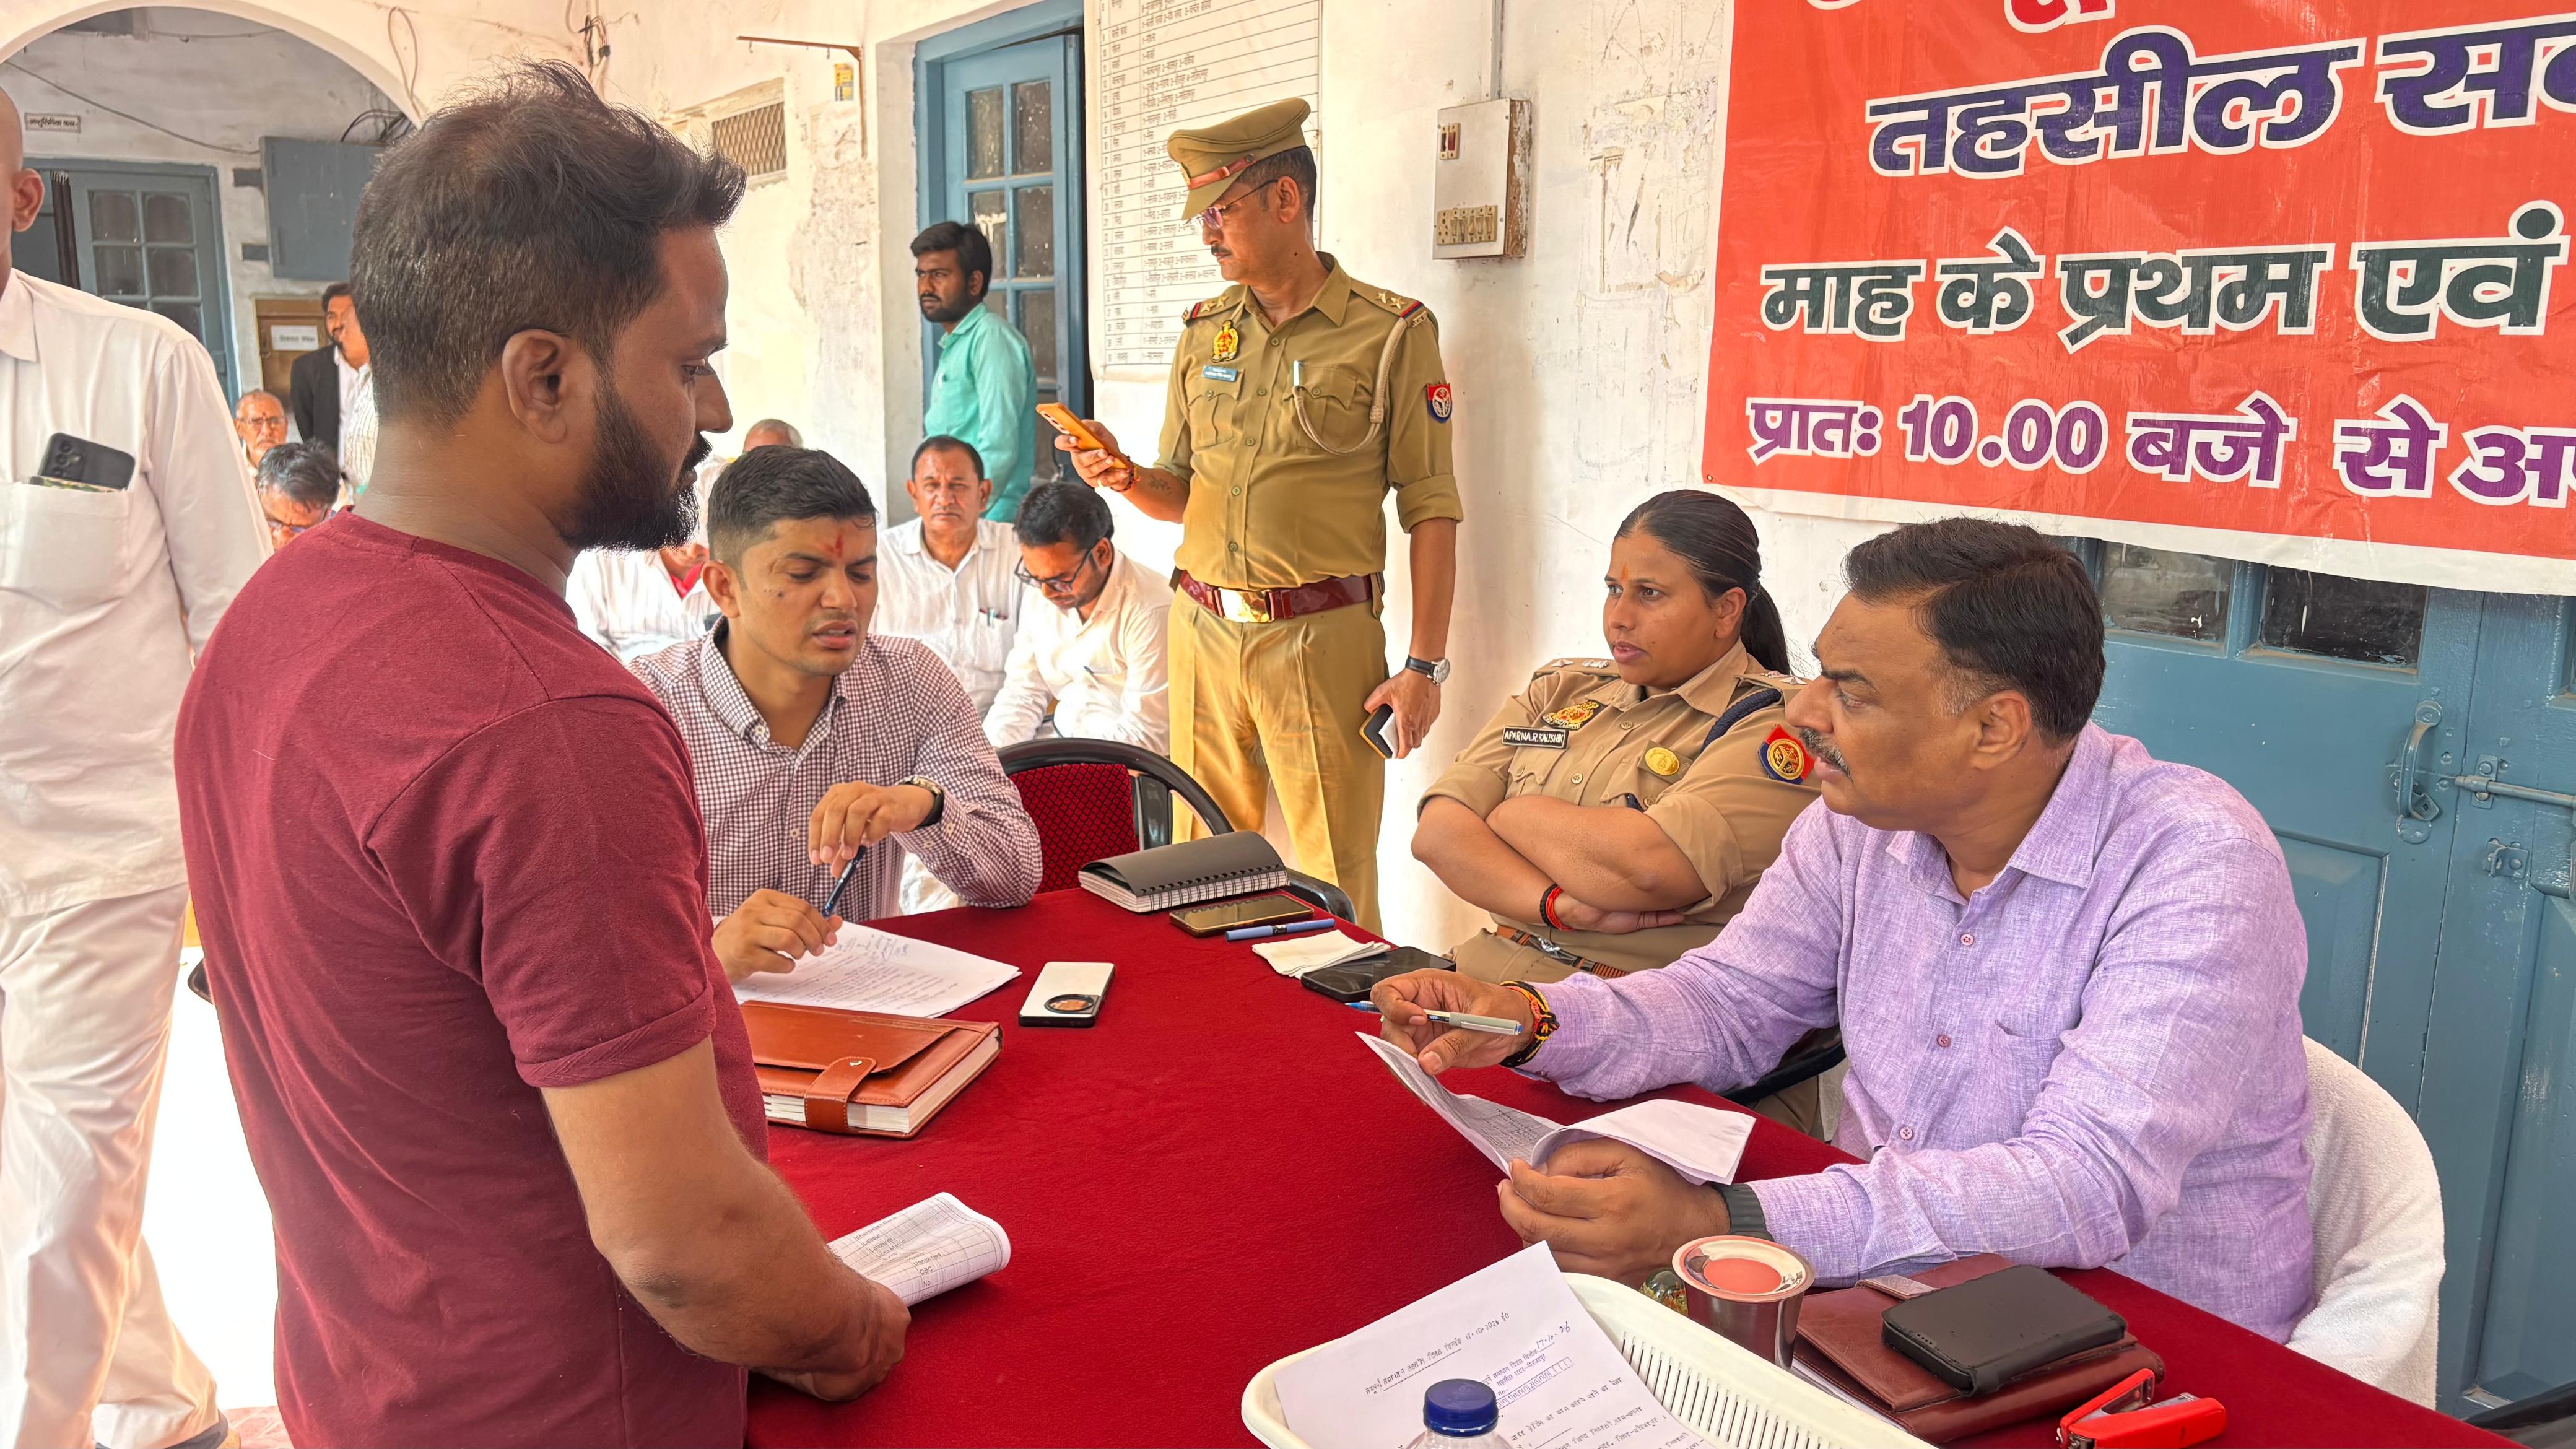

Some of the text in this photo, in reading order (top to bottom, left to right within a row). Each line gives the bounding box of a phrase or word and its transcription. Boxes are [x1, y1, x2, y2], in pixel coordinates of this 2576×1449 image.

[1869, 31, 2359, 174] तहसील
[1764, 207, 2562, 347] माह के प्रथम एवं
[1750, 398, 2576, 500] प्रातः 10.00 बजे से अ
